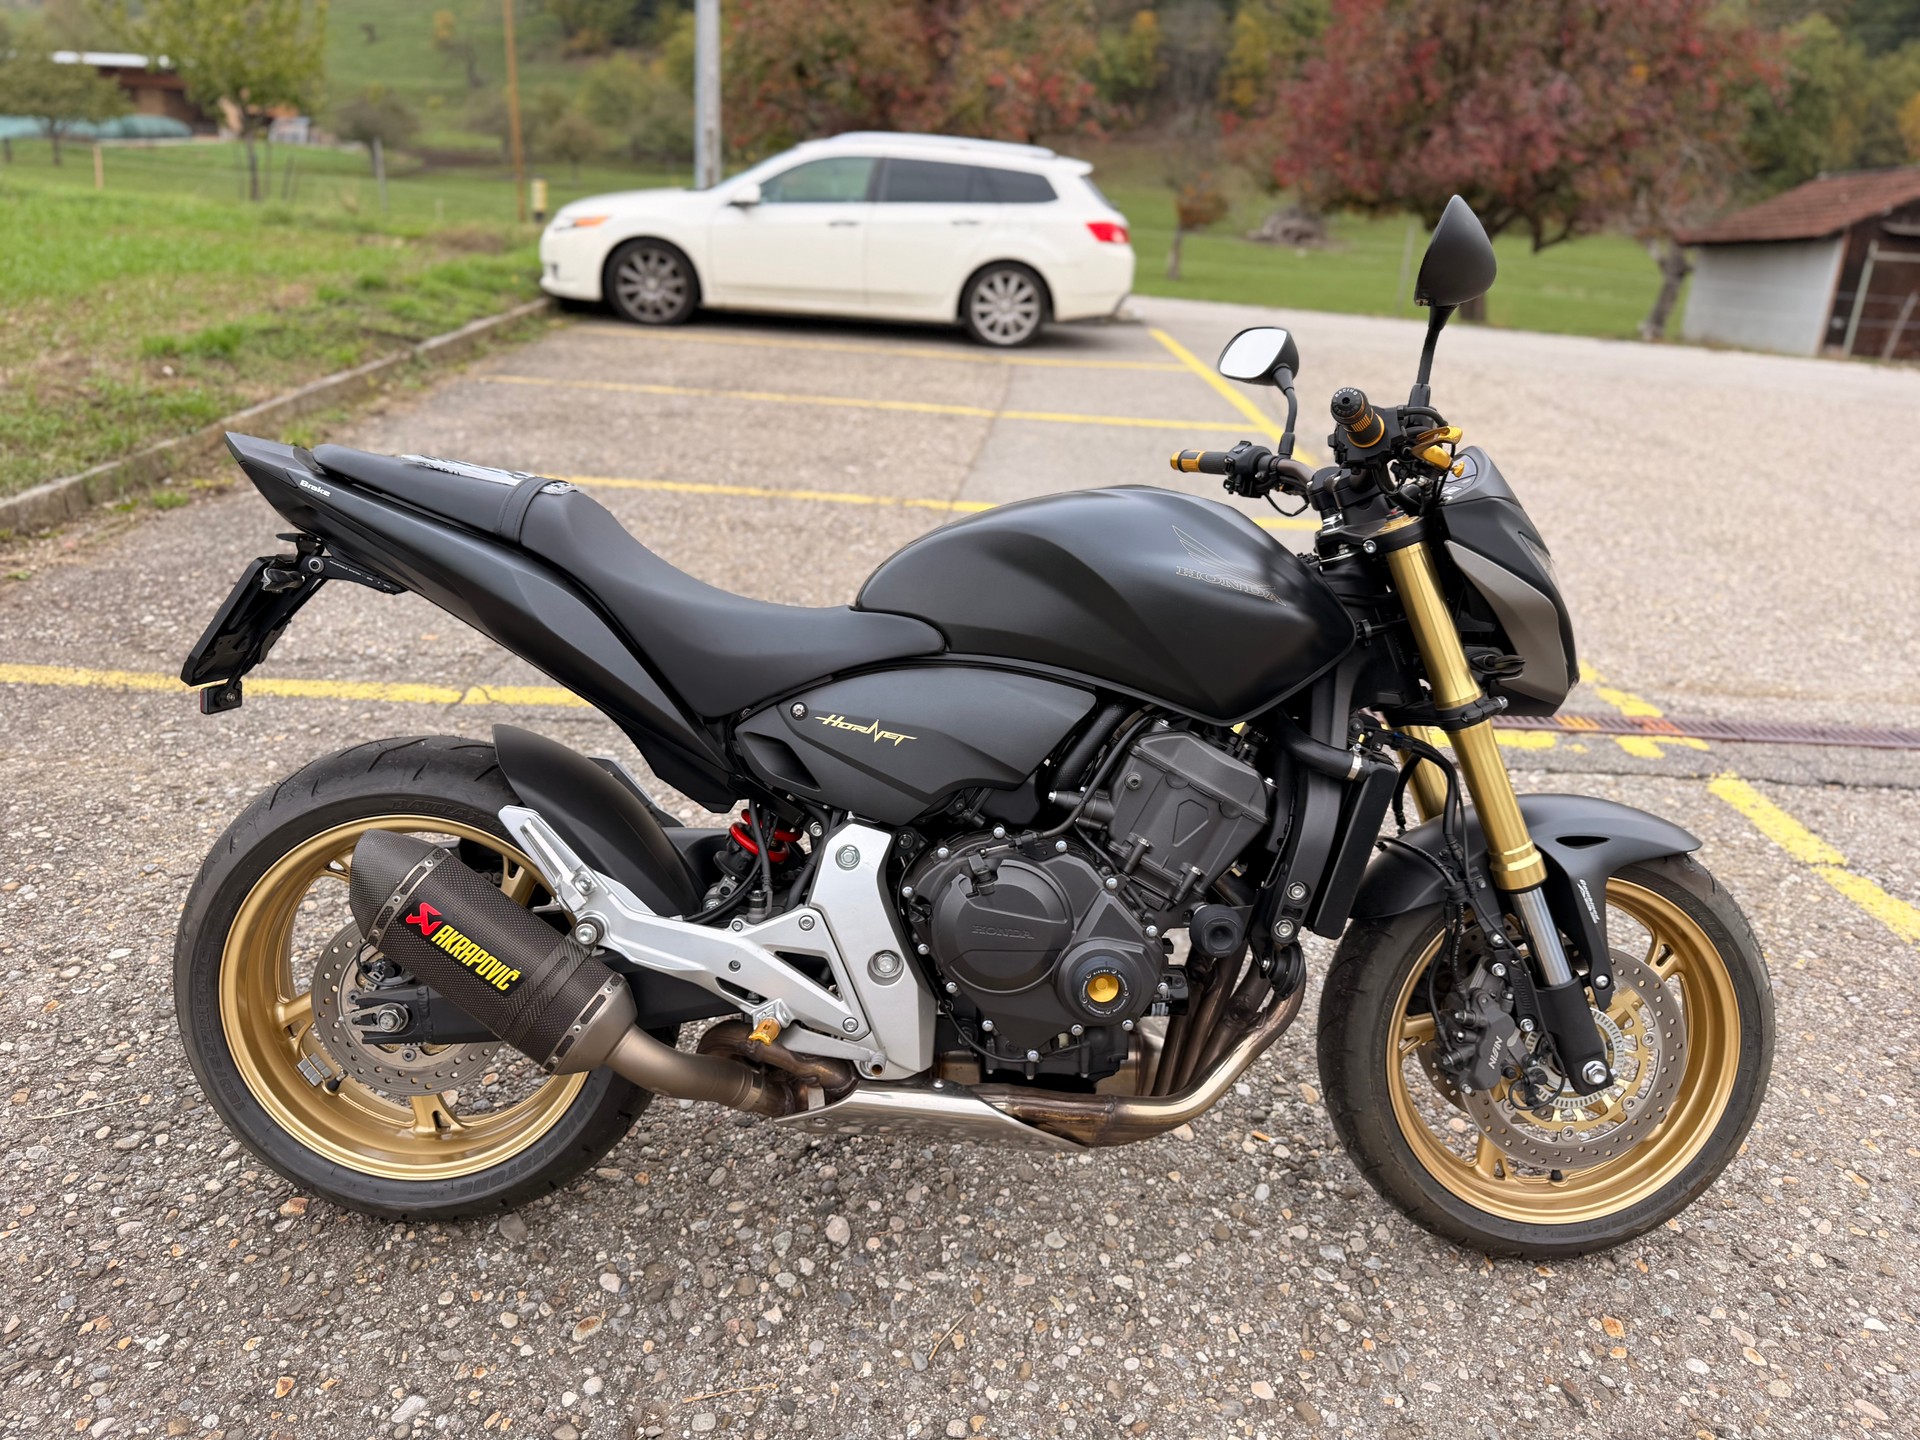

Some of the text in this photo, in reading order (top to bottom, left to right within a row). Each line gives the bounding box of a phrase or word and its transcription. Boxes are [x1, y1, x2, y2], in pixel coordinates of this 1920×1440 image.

[299, 479, 331, 497] Brake
[1175, 565, 1287, 607] HONDA
[971, 924, 1036, 940] HONDA
